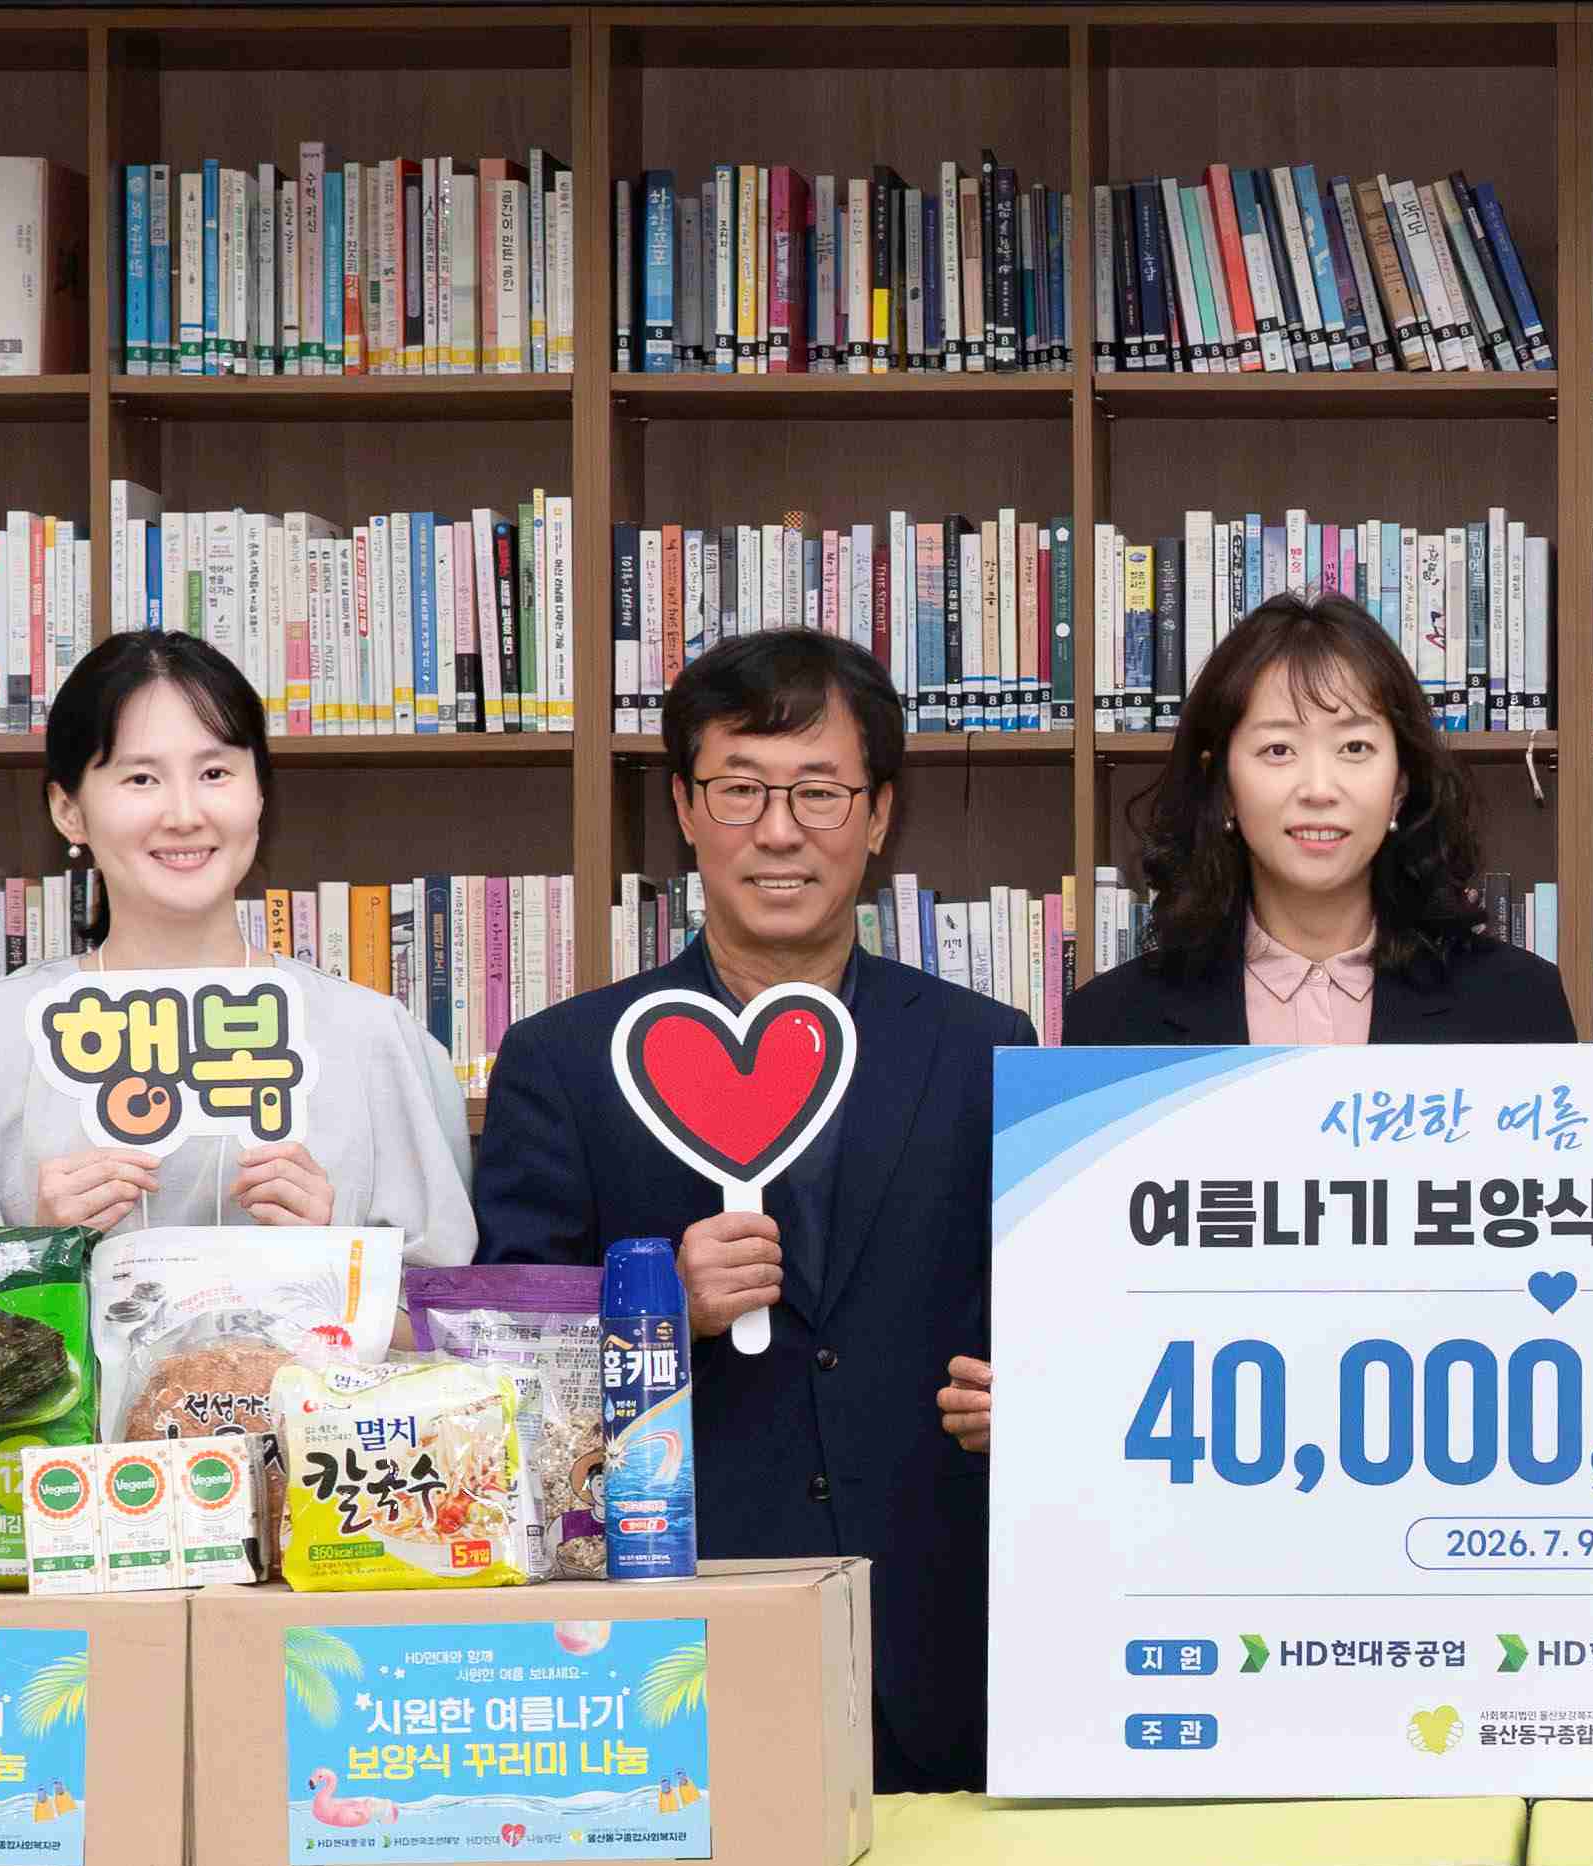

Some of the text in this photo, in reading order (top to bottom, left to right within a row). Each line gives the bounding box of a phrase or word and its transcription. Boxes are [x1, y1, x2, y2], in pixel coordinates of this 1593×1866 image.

[46, 988, 300, 1140] 행복
[1320, 1089, 1473, 1148] 시원한
[1497, 1083, 1583, 1150] 여름
[1128, 1177, 1388, 1247] 여름나기
[354, 1414, 418, 1451] 멸치
[39, 1480, 80, 1498] Vegemil
[115, 1476, 156, 1494] Vegemil
[191, 1471, 232, 1488] Vegemil
[301, 1448, 448, 1534] 칼국수
[1447, 1529, 1534, 1556] 2026.
[1544, 1530, 1567, 1556] 7.
[1281, 1638, 1465, 1669] HD현대중공업
